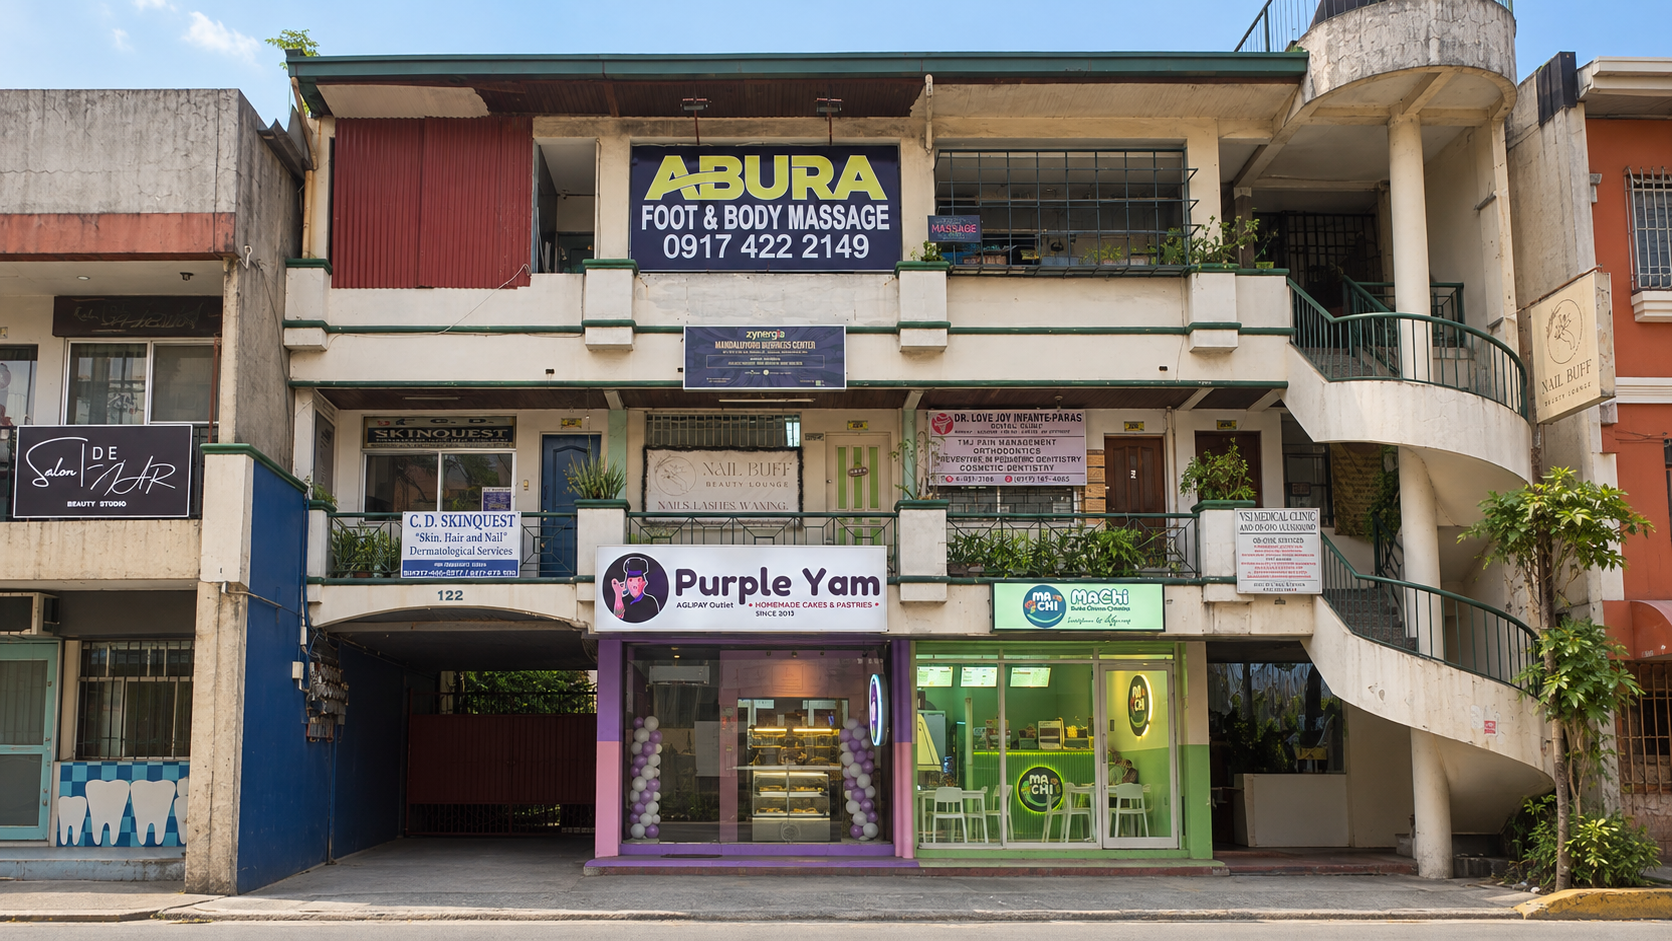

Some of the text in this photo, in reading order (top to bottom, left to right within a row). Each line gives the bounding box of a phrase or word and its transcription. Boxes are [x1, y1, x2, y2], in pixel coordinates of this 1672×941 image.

[644, 155, 888, 200] ABURA
[641, 204, 890, 230] FOOT & BODY MASSAGE
[931, 224, 977, 233] MASSAGE
[663, 234, 869, 259] 0917 422 2149
[1541, 358, 1592, 395] NAIL BUFF
[954, 413, 1082, 423] DR. LOVE JOY INFANTE-PARAS
[93, 446, 117, 460] DE
[26, 437, 88, 488] Salon
[702, 462, 792, 476] NAIL BUFF
[1254, 512, 1288, 521] MEDICAL
[1290, 511, 1316, 521] CLINIC
[410, 514, 516, 530] C. D. SKINQUEST
[444, 533, 465, 543] Hair
[466, 533, 483, 543] and
[410, 546, 513, 557] Dermatological Services
[675, 567, 880, 605] Purple Yam
[437, 589, 463, 601] 122
[1032, 592, 1051, 601] MA
[709, 601, 734, 609] Outlet
[1037, 601, 1058, 611] CHI
[1029, 774, 1049, 785] MA
[1031, 784, 1054, 795] CHI
